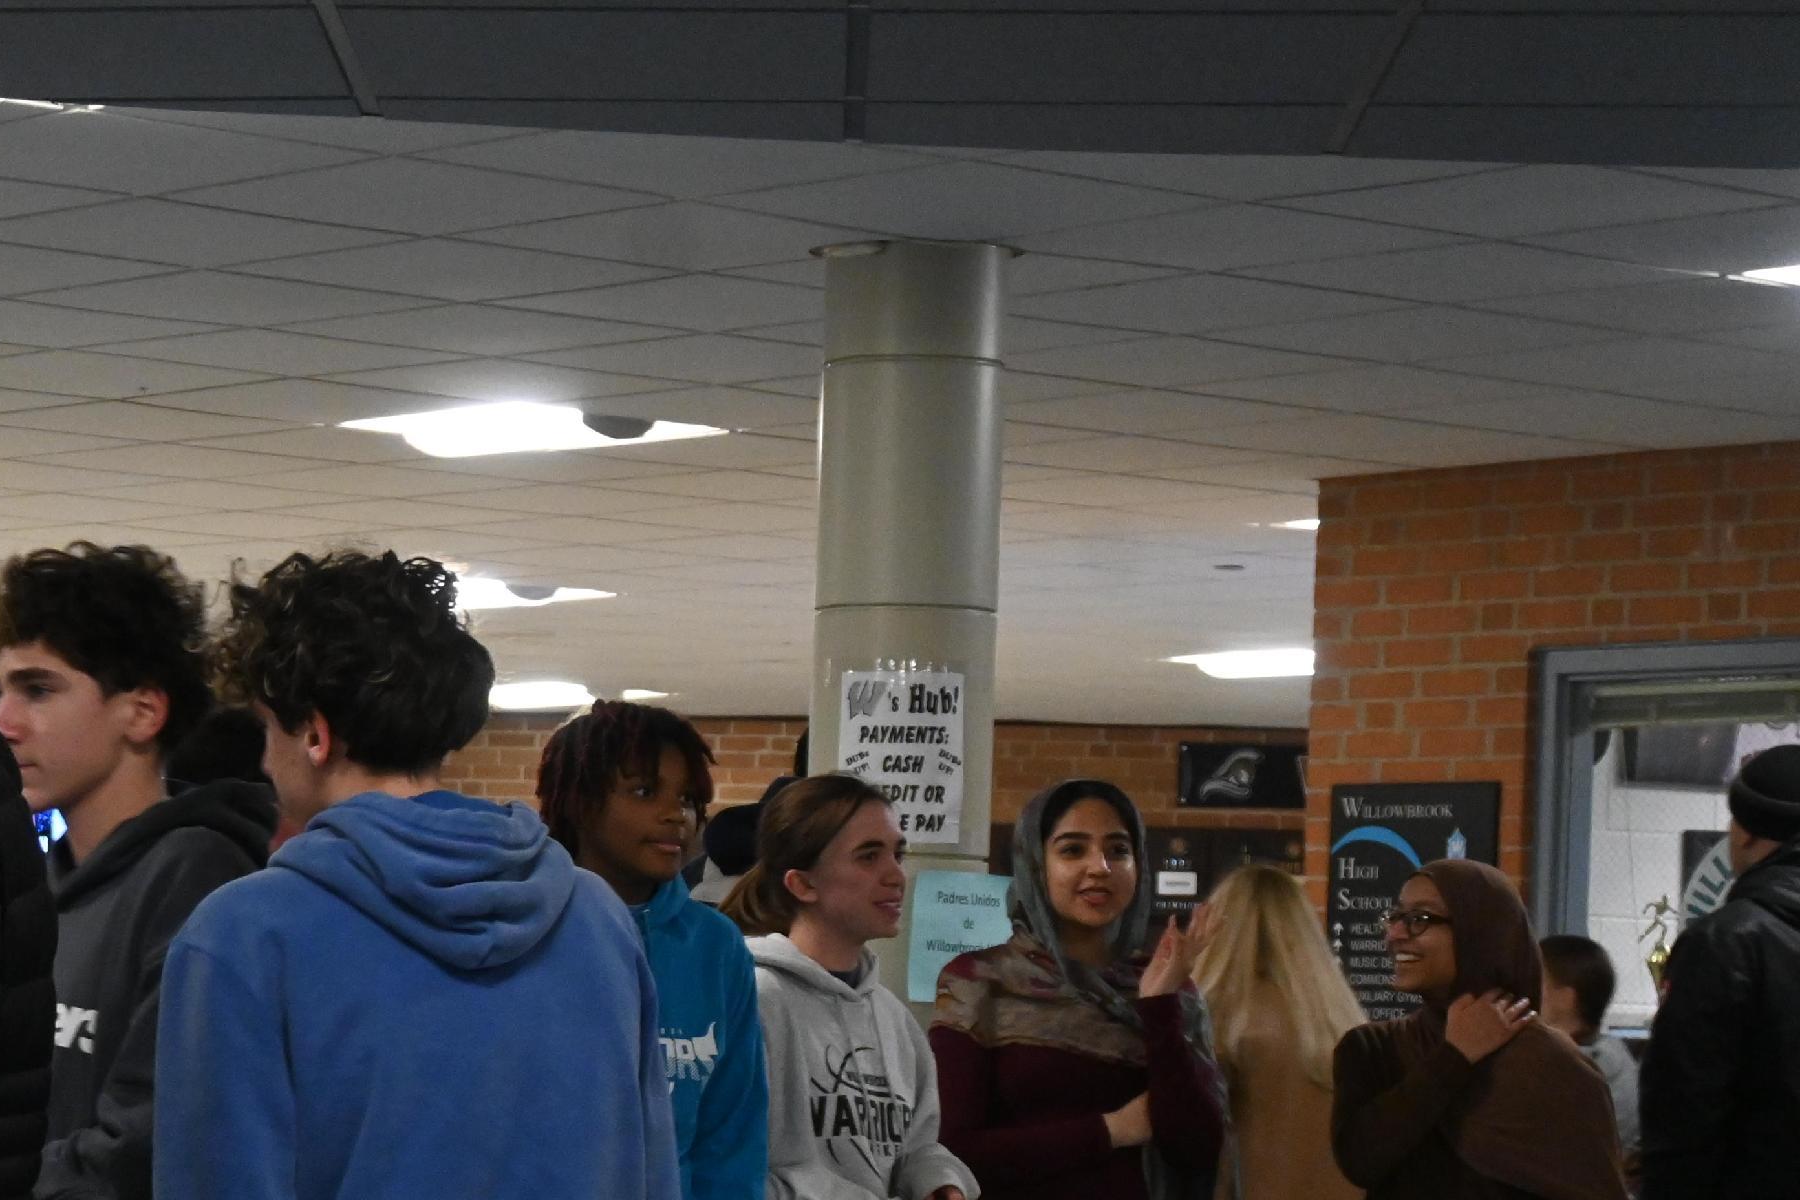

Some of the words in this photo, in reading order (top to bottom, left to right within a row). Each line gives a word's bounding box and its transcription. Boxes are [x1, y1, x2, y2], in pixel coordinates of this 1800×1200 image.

[909, 683, 959, 715] Hub!
[859, 725, 949, 745] PAYMENTS:
[882, 755, 925, 773] CASH
[881, 785, 920, 802] EDIT
[924, 785, 946, 804] OR
[915, 814, 946, 832] PAY
[937, 891, 969, 905] Padres
[971, 893, 1000, 908] Unidos
[963, 917, 974, 930] de
[1350, 957, 1378, 968] MUSIC
[1350, 974, 1397, 985] COMMONS
[1371, 1008, 1406, 1020] OFFICE
